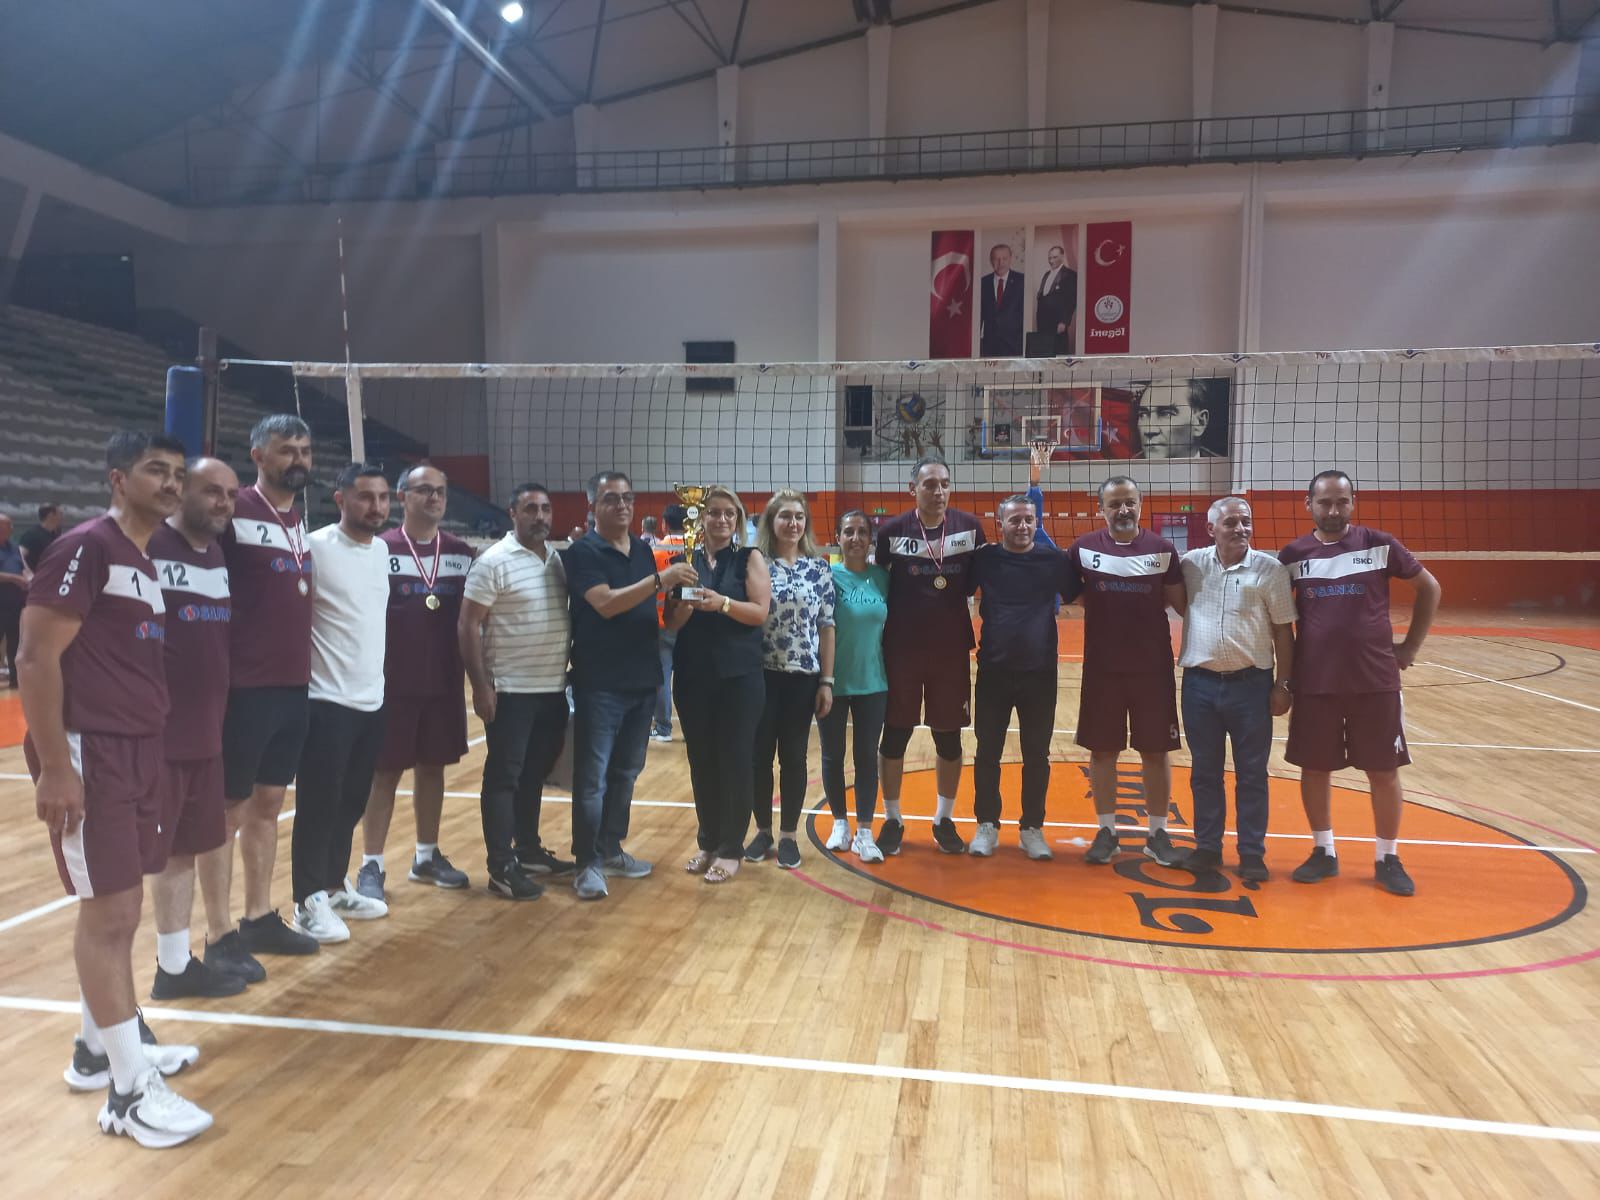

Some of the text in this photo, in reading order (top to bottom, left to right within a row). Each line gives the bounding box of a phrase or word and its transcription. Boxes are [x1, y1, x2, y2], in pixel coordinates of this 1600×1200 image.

[256, 524, 273, 544] 2
[903, 539, 919, 554] 10
[389, 557, 401, 573] 8
[445, 559, 462, 570] ISKO
[1092, 554, 1101, 569] 5
[1144, 560, 1161, 568] ISKO
[1299, 560, 1310, 577] 11
[1352, 557, 1373, 565] ISKO
[58, 545, 84, 596] ISKO
[162, 563, 190, 587] 12
[131, 571, 142, 597] 1
